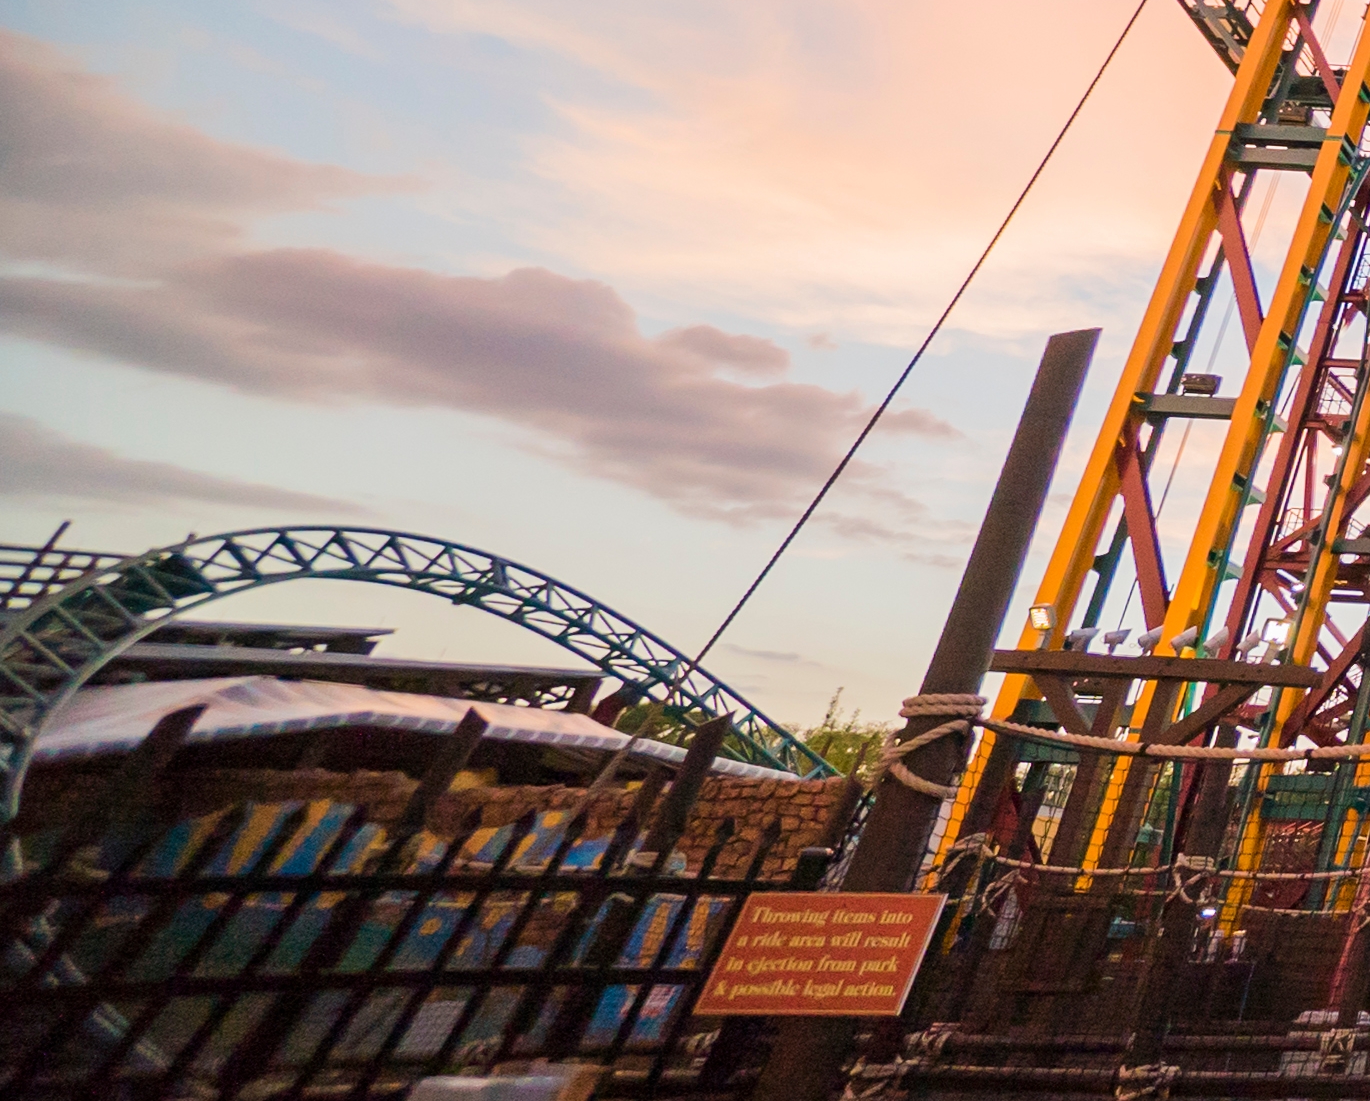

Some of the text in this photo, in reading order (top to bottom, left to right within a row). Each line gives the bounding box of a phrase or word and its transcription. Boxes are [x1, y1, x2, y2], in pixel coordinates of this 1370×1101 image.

[752, 906, 914, 927] Throwing items into
[736, 931, 911, 948] a ride area will result
[725, 954, 899, 976] in ejection from park
[713, 979, 896, 1001] & possible legal action.
